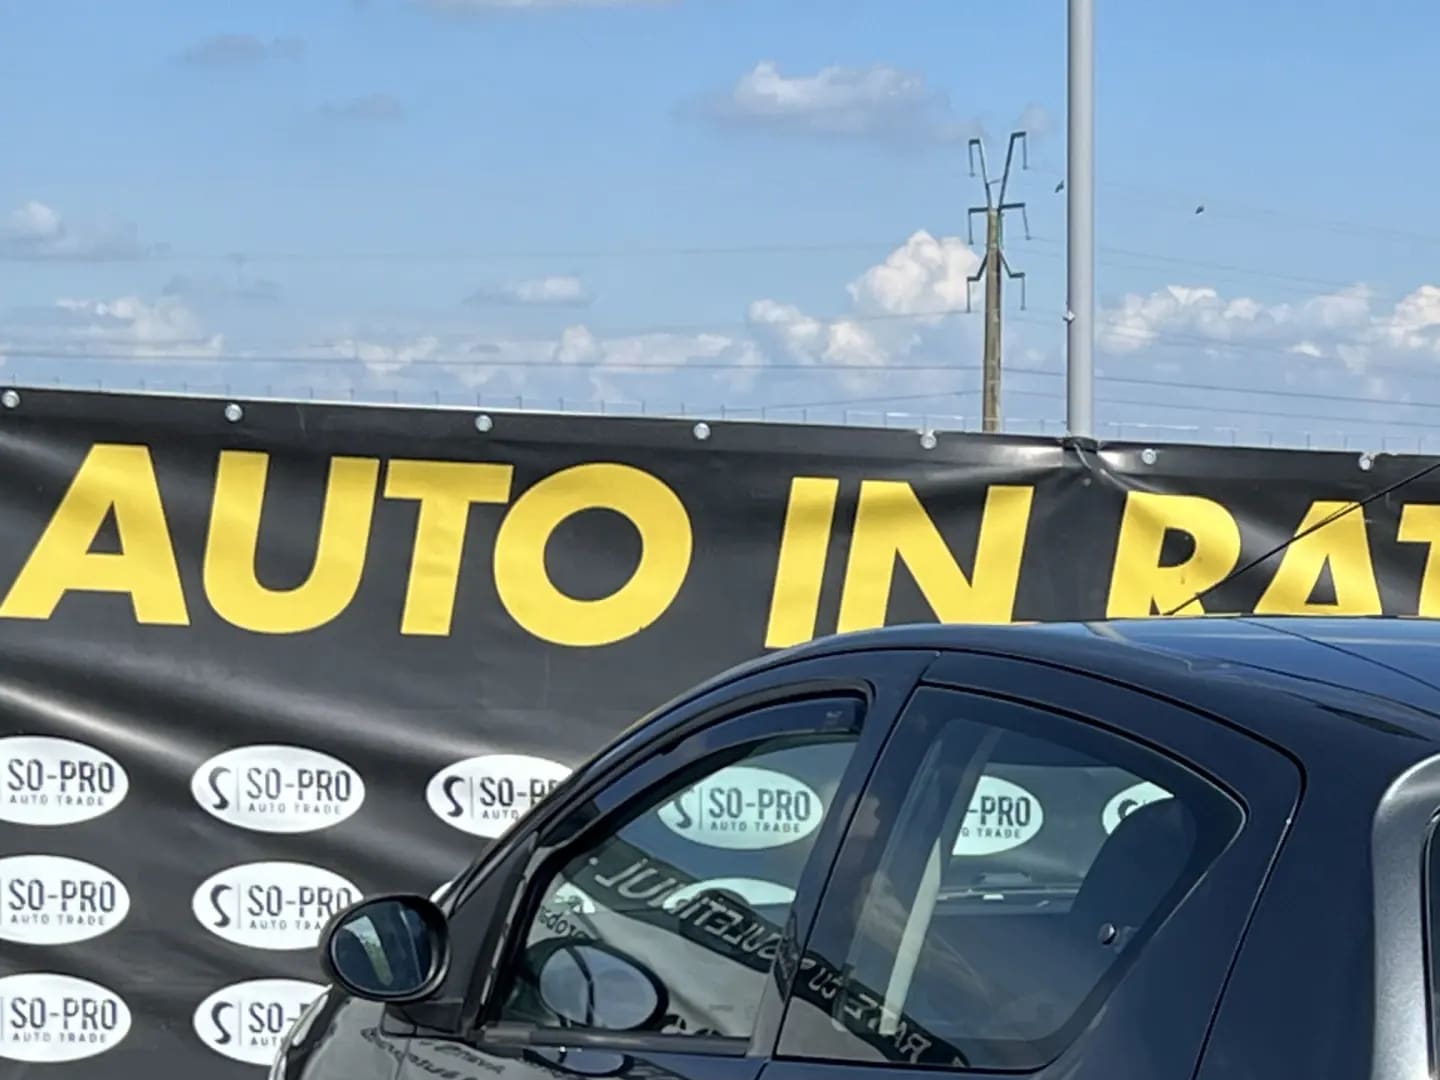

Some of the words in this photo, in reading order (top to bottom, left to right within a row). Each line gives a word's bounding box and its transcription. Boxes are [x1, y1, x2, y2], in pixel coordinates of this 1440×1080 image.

[0, 443, 692, 647] AUTO
[764, 476, 1035, 649] IN
[8, 758, 115, 795] SO-PRO
[247, 767, 351, 803] SO-PRO
[479, 776, 561, 807] SO-P
[709, 787, 811, 821] SO-PRO
[9, 879, 116, 912] SO-PRO
[296, 920, 322, 930] TRA
[10, 998, 117, 1030] SO-PRO
[251, 1037, 277, 1047] AUT
